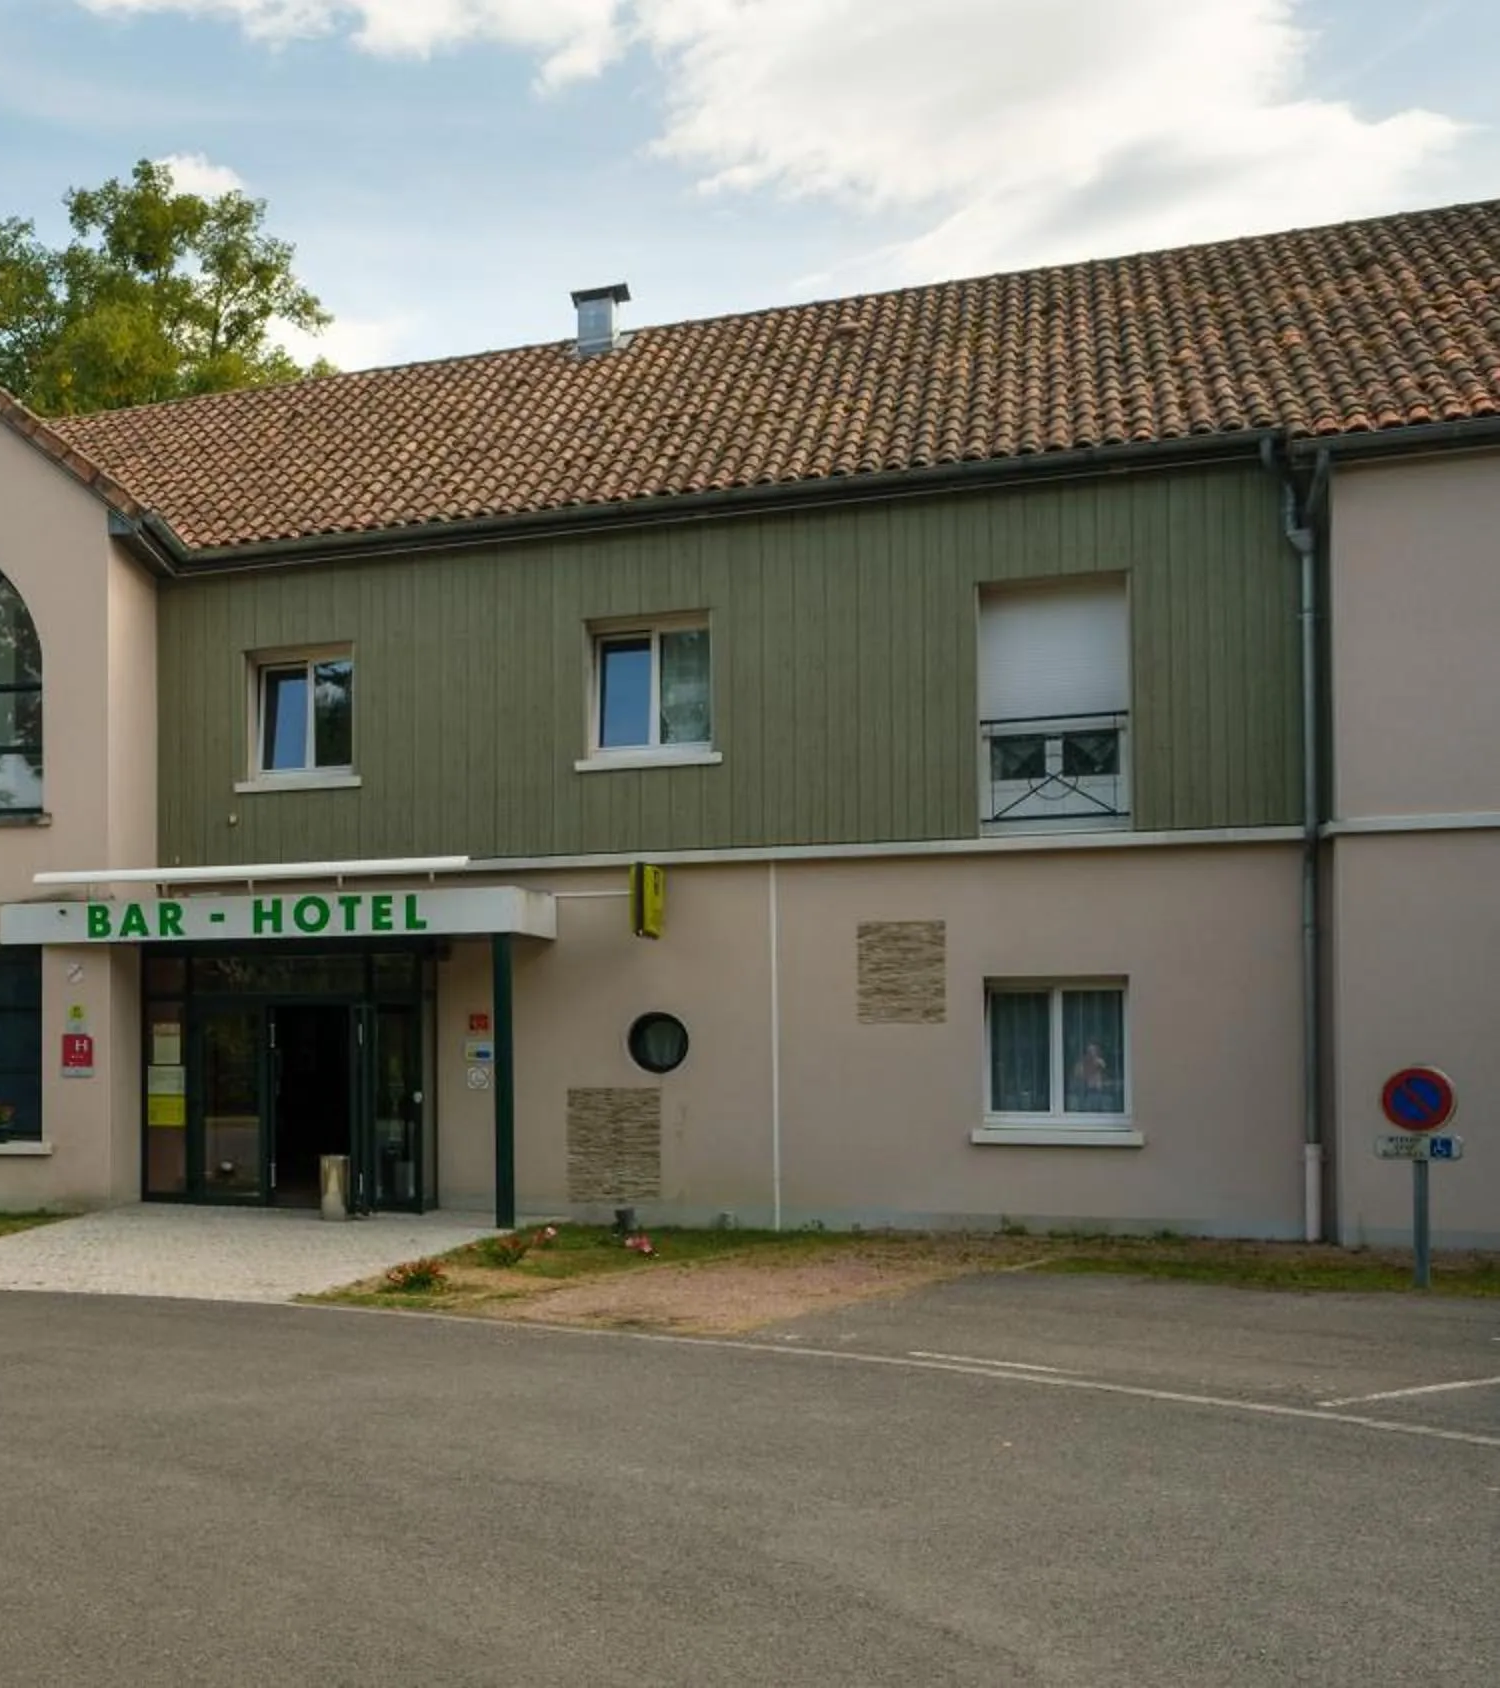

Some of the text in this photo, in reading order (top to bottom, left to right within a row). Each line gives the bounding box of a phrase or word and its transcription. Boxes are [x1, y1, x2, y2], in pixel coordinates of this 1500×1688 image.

[87, 894, 428, 938] BAR - HOTEL
[75, 1039, 88, 1052] H
